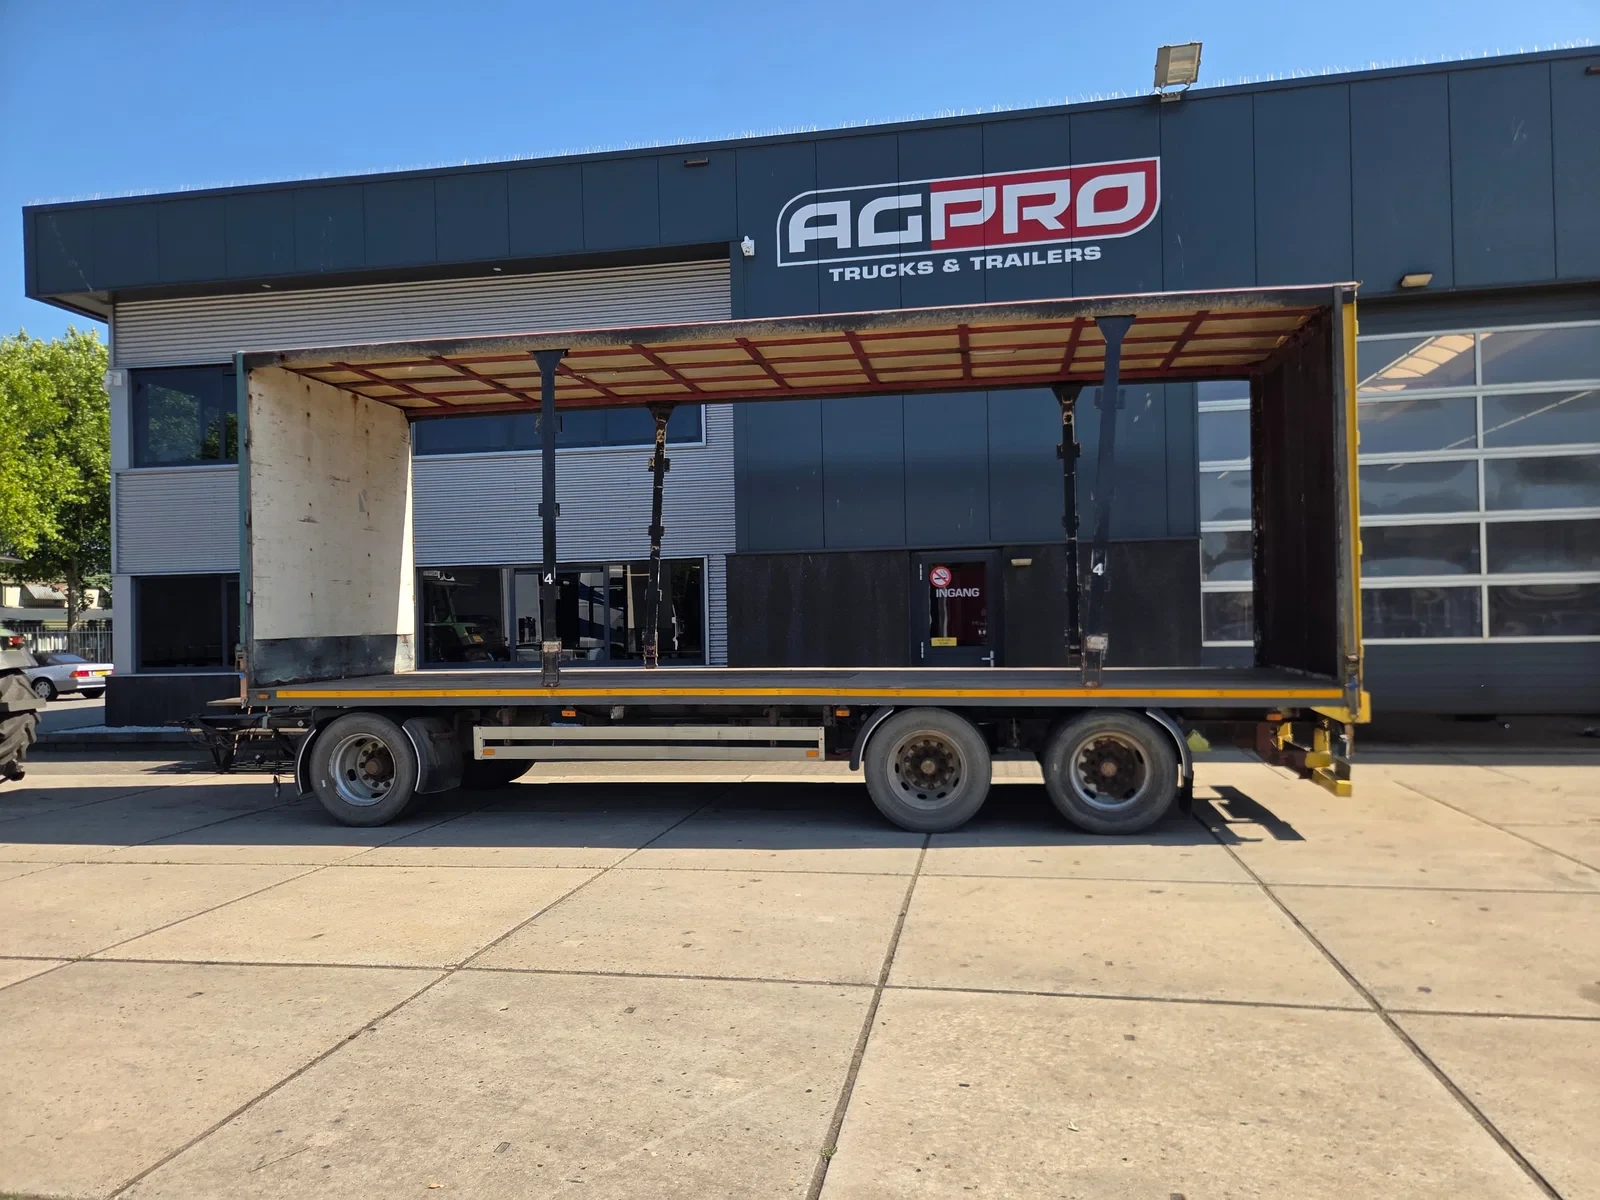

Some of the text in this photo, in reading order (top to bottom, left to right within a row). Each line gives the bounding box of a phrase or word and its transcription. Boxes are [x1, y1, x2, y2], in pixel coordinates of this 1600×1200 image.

[788, 171, 1146, 253] AGPRO
[829, 246, 1102, 282] TRUCKS & TRAILERS
[1092, 562, 1104, 576] 4
[544, 572, 554, 585] 4
[935, 587, 980, 598] INGANG
